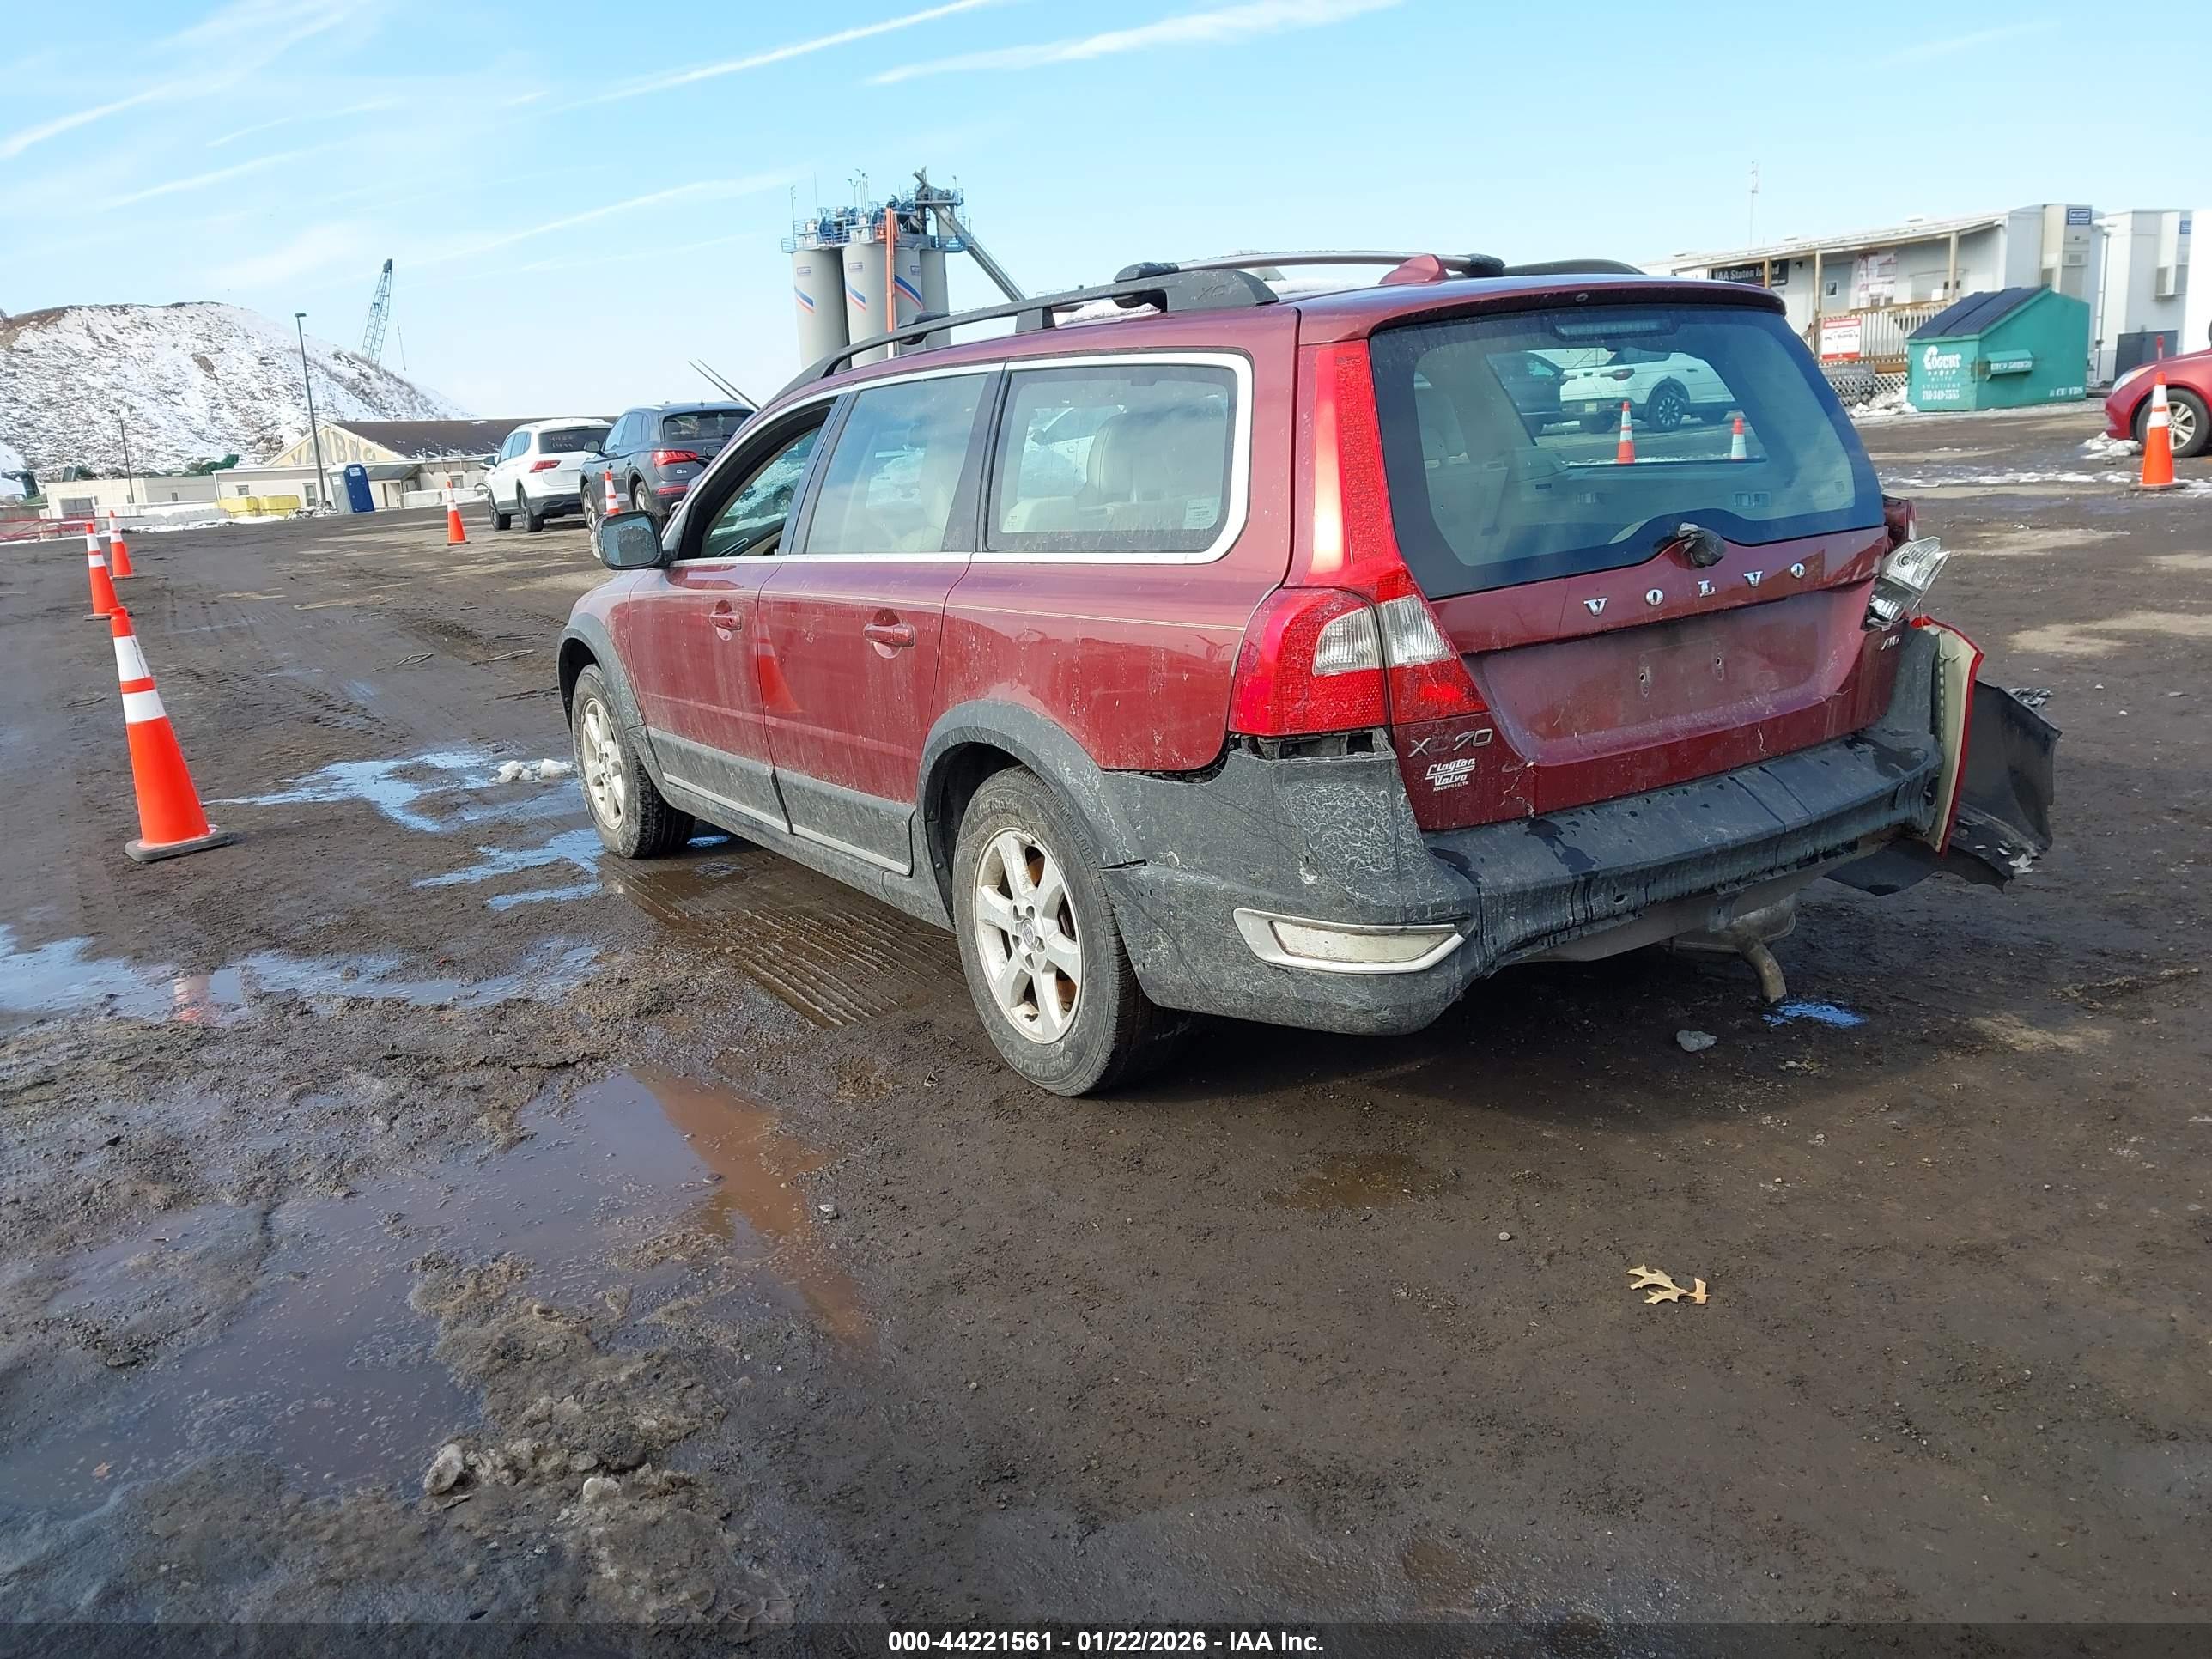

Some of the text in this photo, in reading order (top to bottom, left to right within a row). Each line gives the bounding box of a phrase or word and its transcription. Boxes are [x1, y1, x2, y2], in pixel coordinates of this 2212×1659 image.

[1730, 268, 1754, 280] Staten
[1755, 264, 1780, 277] Isnd
[1583, 562, 1806, 616] VOLVO
[1425, 758, 1476, 776] Clayton
